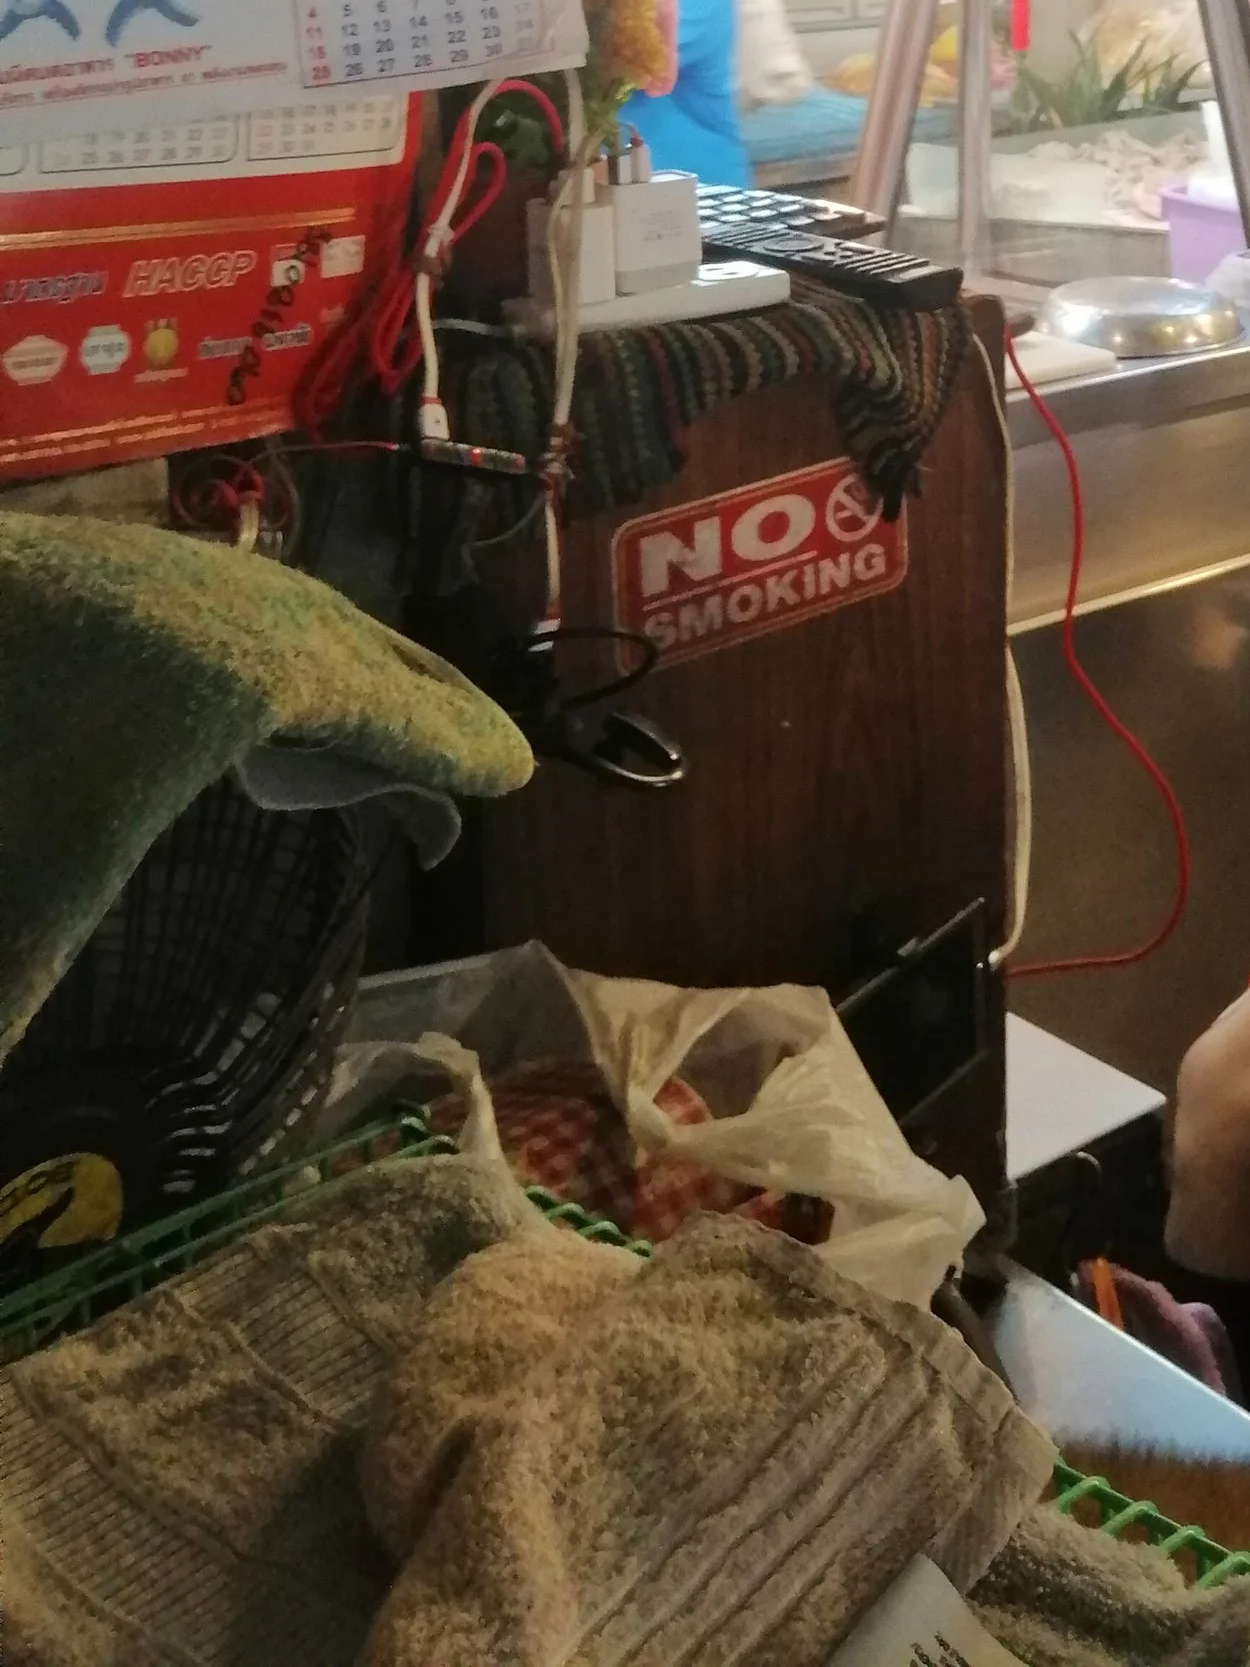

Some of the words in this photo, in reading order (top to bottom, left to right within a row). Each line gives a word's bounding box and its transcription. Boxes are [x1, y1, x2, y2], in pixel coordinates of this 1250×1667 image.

[344, 4, 351, 16] 5
[376, 0, 387, 12] 6
[342, 23, 358, 36] 12
[374, 20, 391, 32] 13
[409, 16, 427, 28] 14
[445, 12, 464, 24] 15
[343, 43, 361, 56] 19
[376, 39, 394, 53] 20
[411, 36, 429, 48] 21
[448, 30, 466, 43] 22
[377, 58, 395, 73] 27
[121, 250, 258, 299] HACCP
[640, 494, 816, 597] NO
[644, 543, 887, 651] SMOKING
